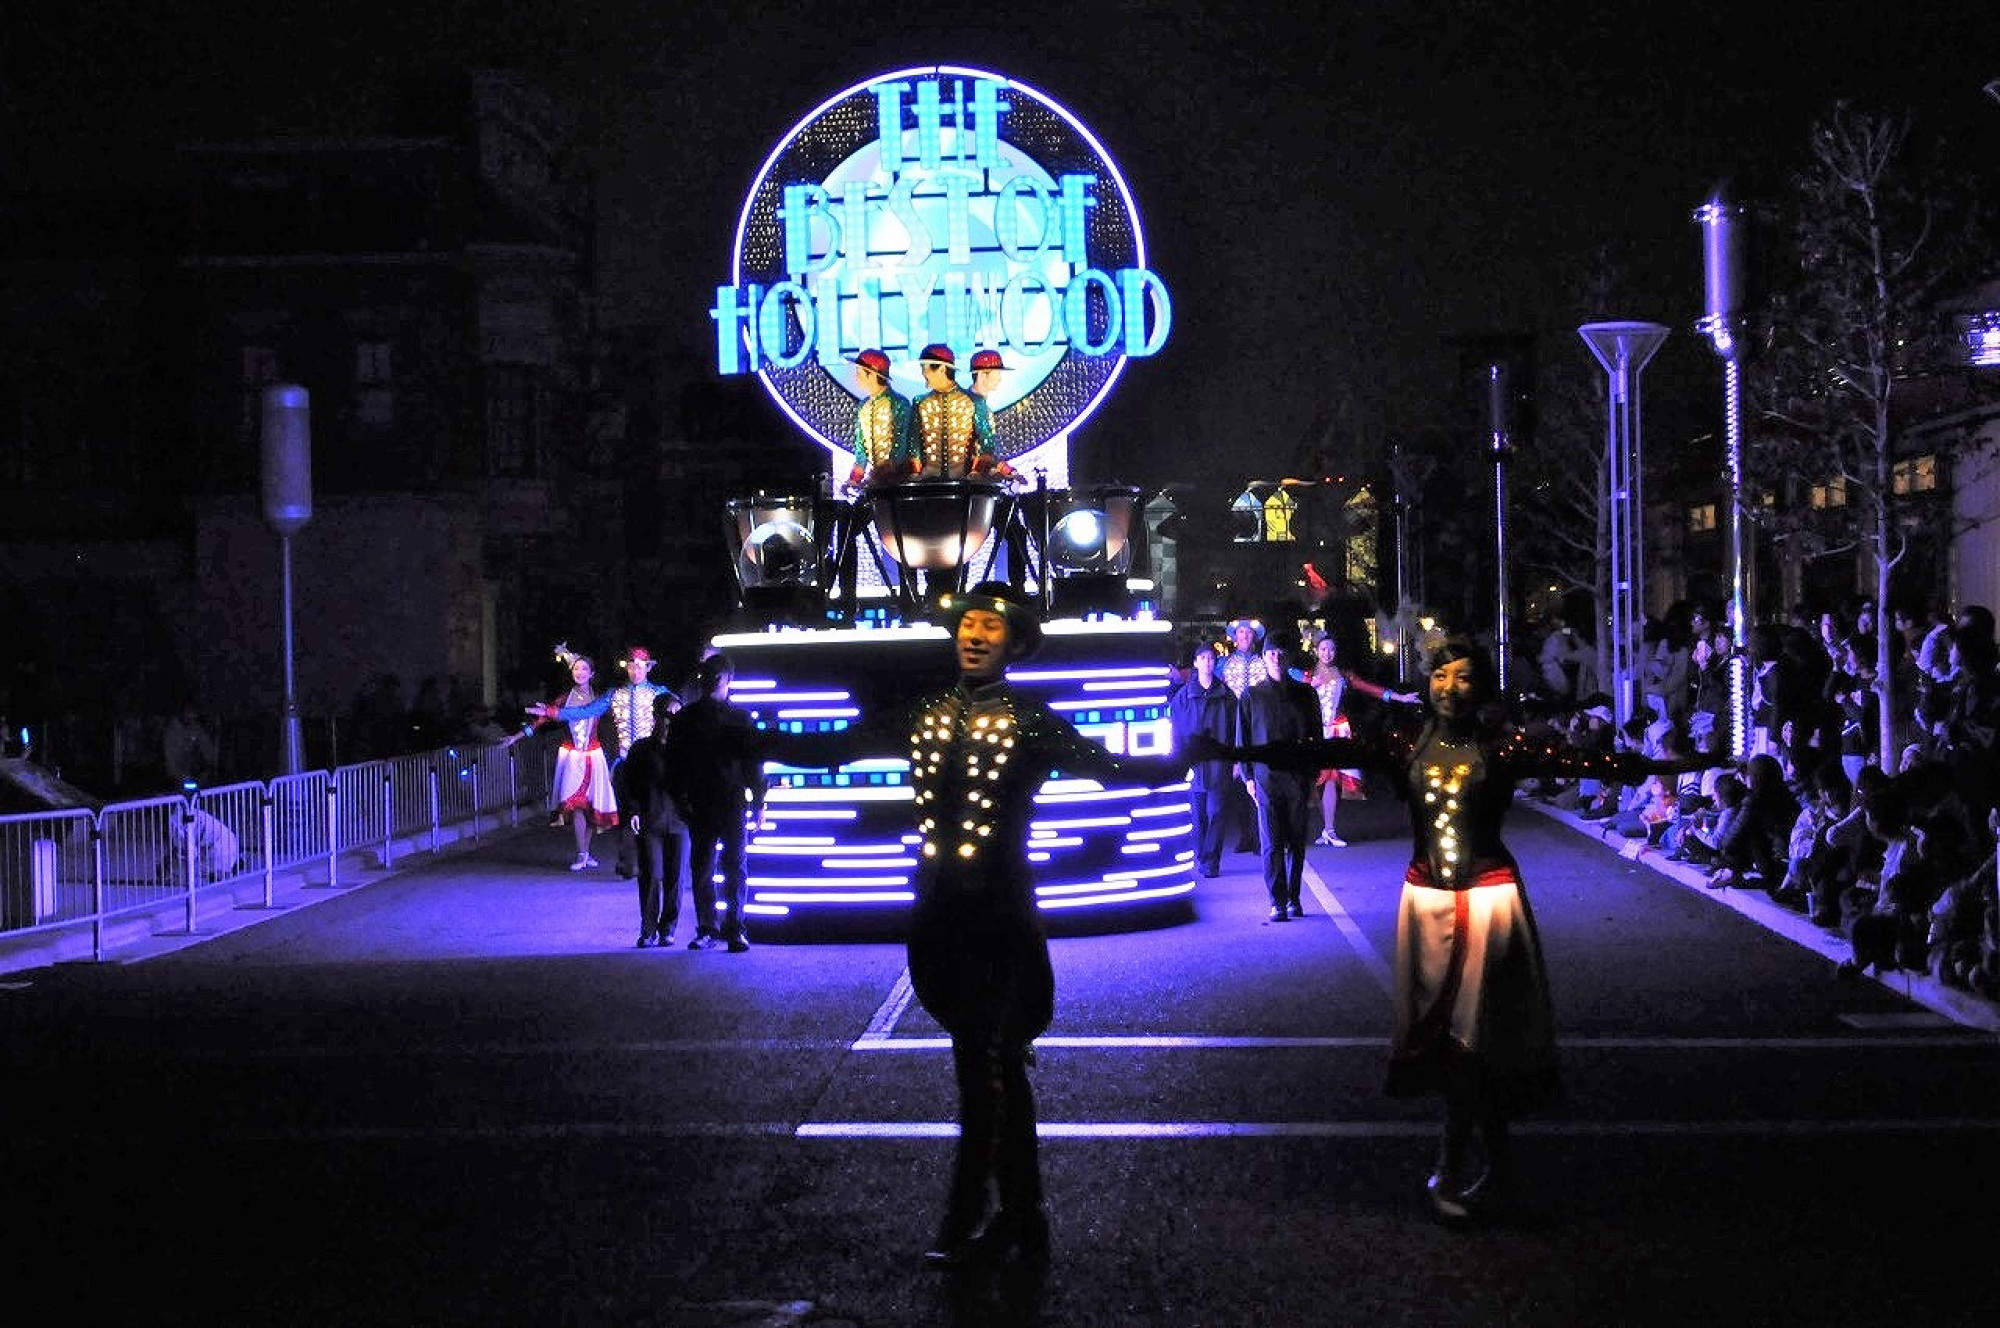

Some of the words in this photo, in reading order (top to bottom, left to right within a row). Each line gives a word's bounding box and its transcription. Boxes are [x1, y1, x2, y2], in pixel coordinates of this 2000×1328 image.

[869, 79, 1012, 172] THE
[777, 174, 981, 275] BEST
[993, 174, 1097, 264] OF
[710, 268, 1172, 376] HOLLYWOOD
